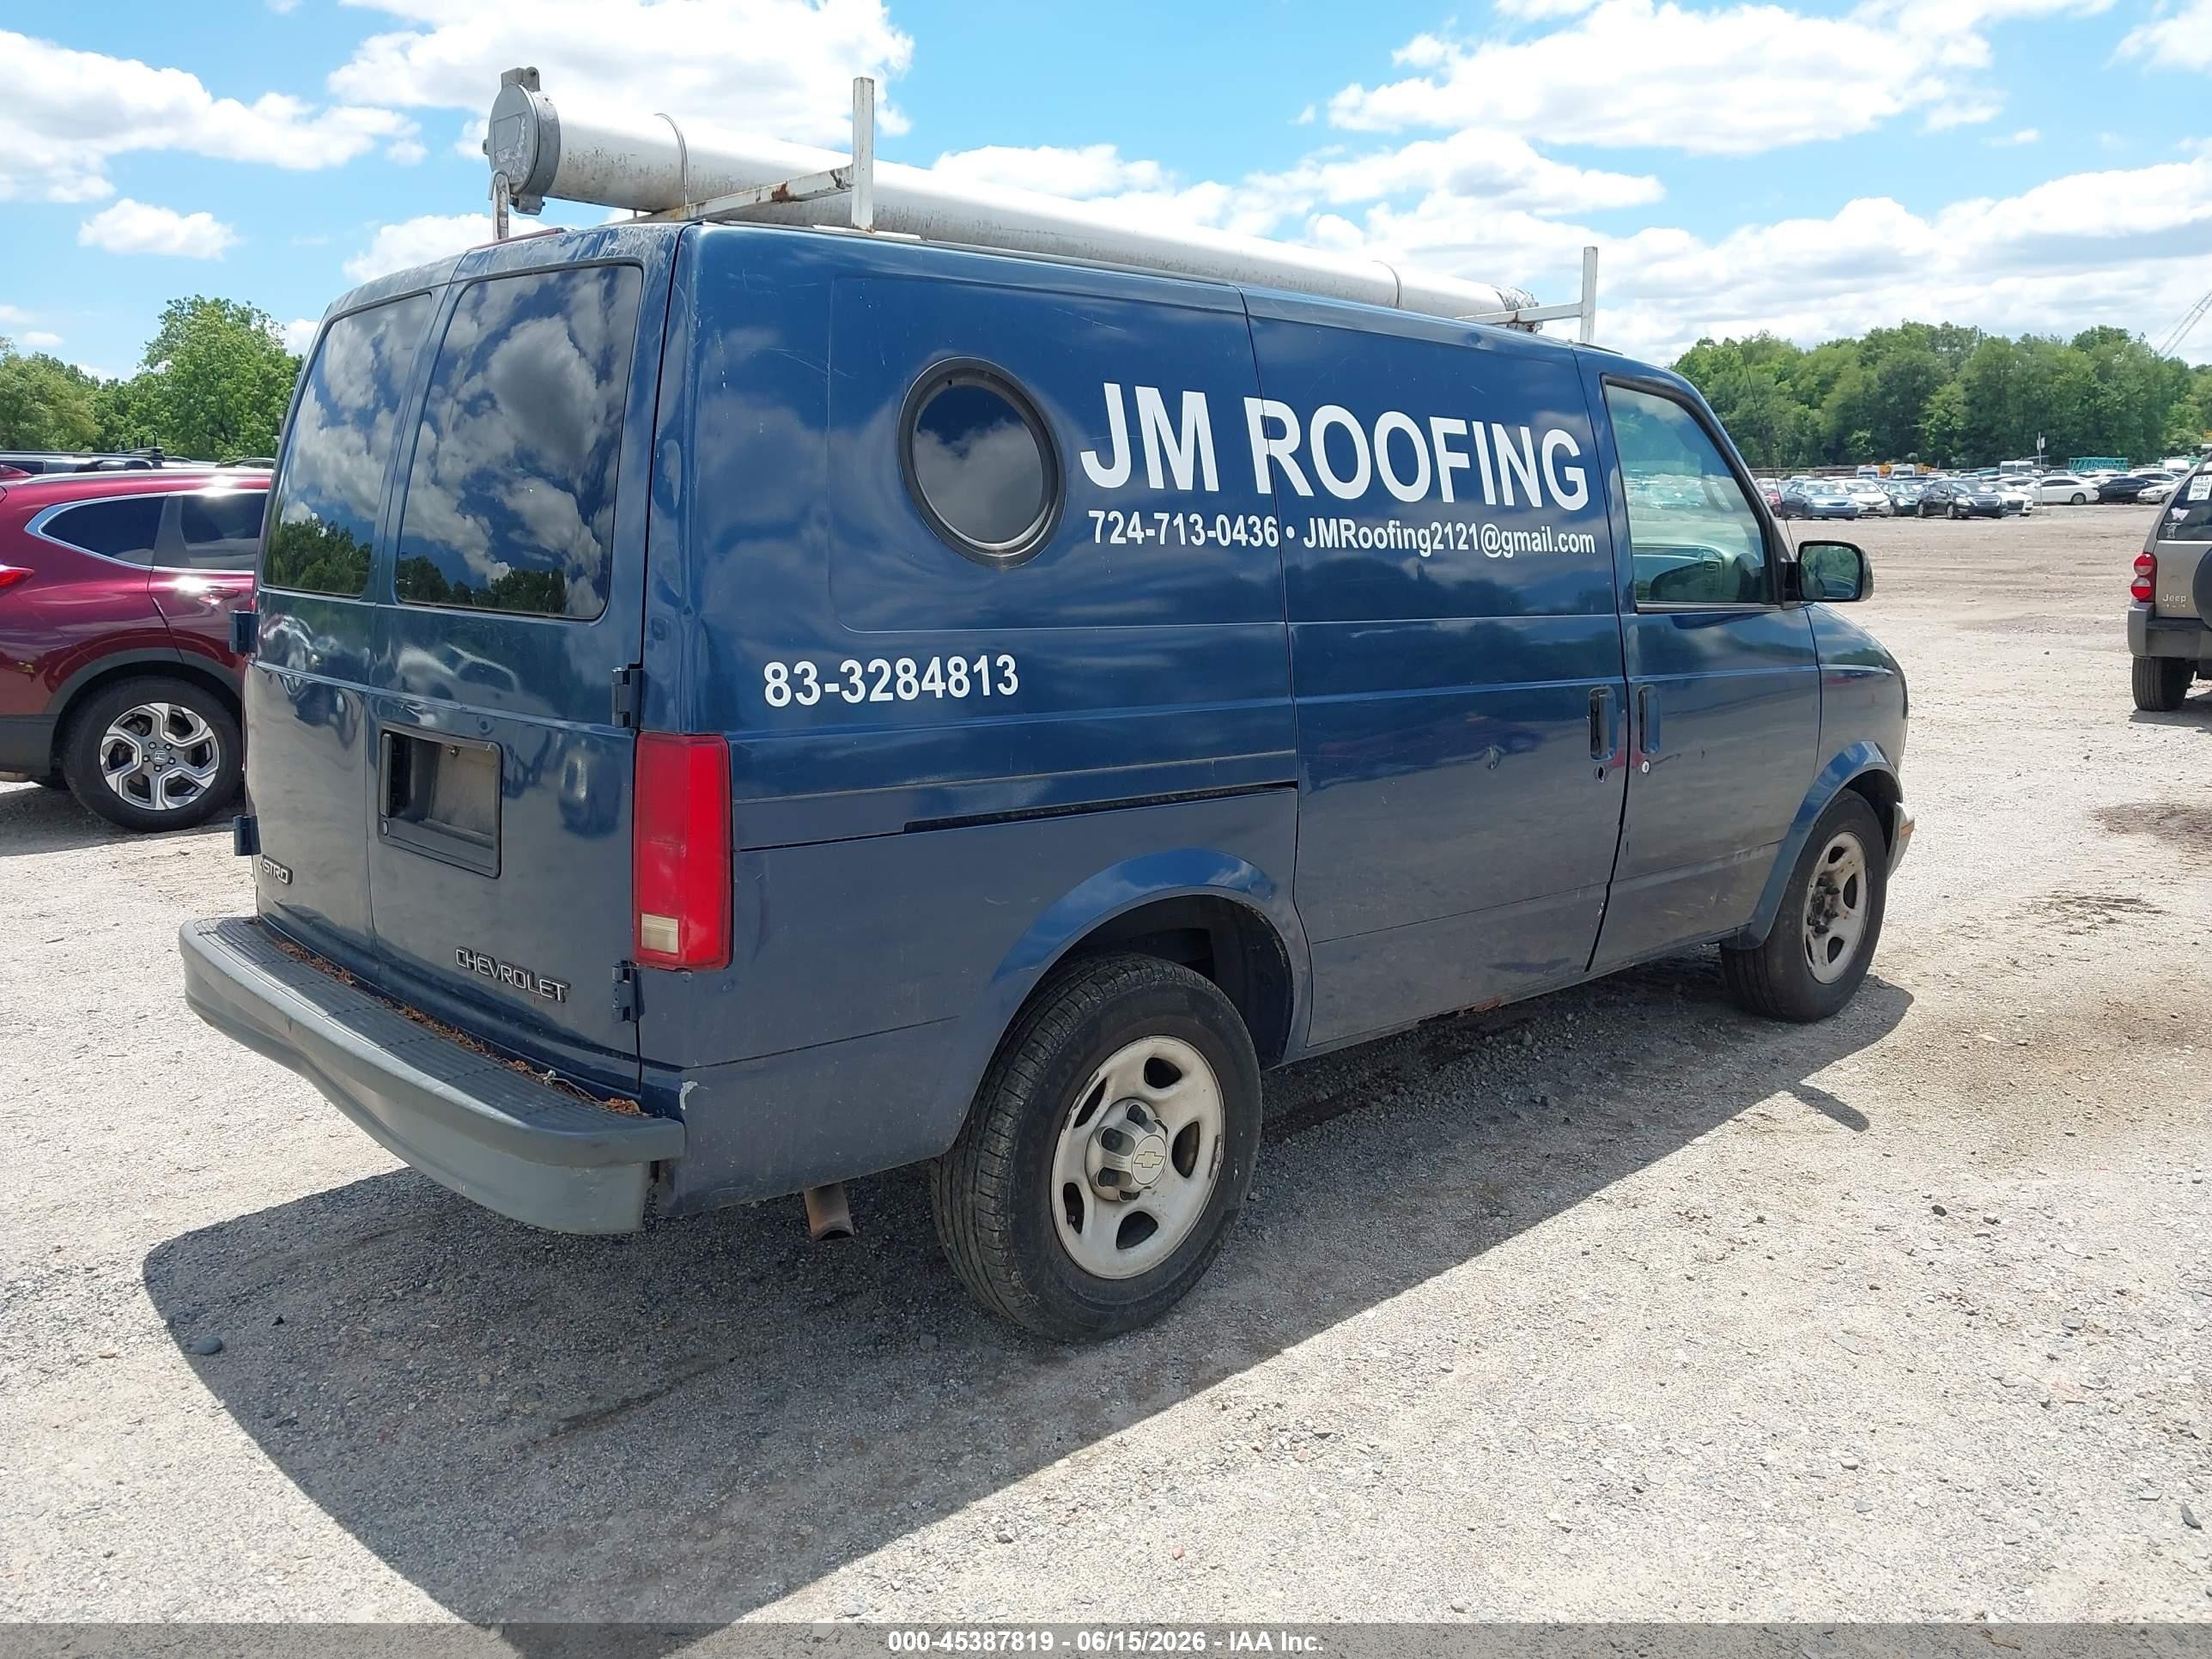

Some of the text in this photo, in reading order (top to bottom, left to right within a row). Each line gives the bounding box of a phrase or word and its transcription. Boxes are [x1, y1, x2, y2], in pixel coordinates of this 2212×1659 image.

[1079, 382, 1589, 511] JM ROOFING
[1088, 510, 1279, 548] 724-713-0436
[1303, 517, 1595, 559] JMRoofing2121@gmail.com
[2162, 593, 2186, 604] Jeep
[763, 654, 1018, 707] 83-3284813
[455, 948, 568, 1003] CHEVROLET
